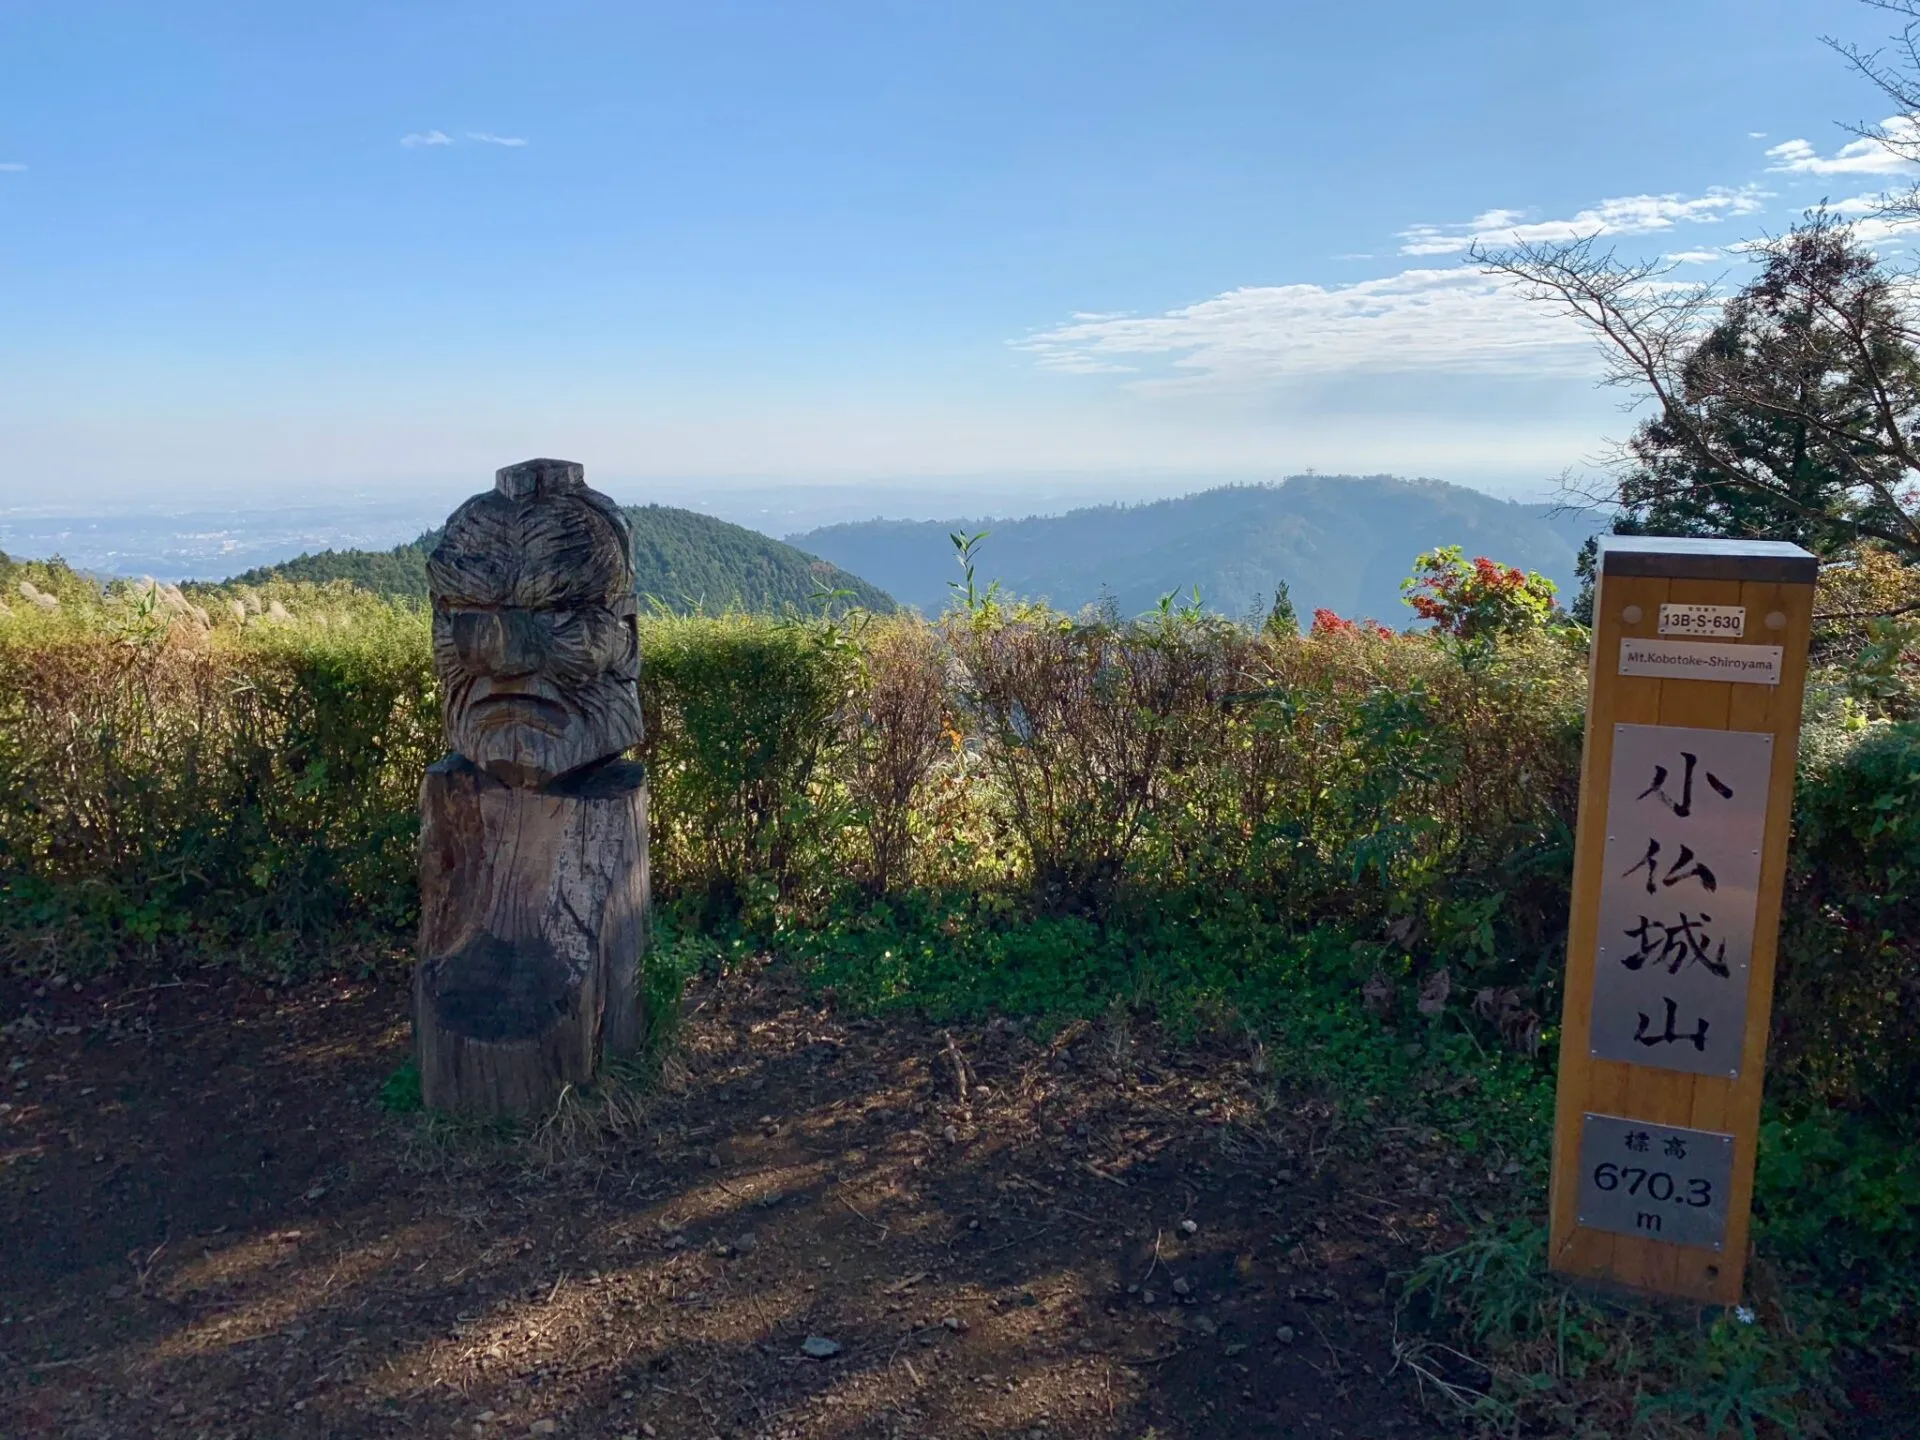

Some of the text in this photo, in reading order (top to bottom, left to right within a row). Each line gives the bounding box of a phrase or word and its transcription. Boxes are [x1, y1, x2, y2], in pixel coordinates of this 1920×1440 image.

[1664, 613, 1741, 630] 13B-S-630
[1622, 751, 1734, 1052] 小仏城山
[1624, 1130, 1688, 1160] 標高
[1593, 1162, 1713, 1208] 670.3
[1636, 1211, 1662, 1232] m
